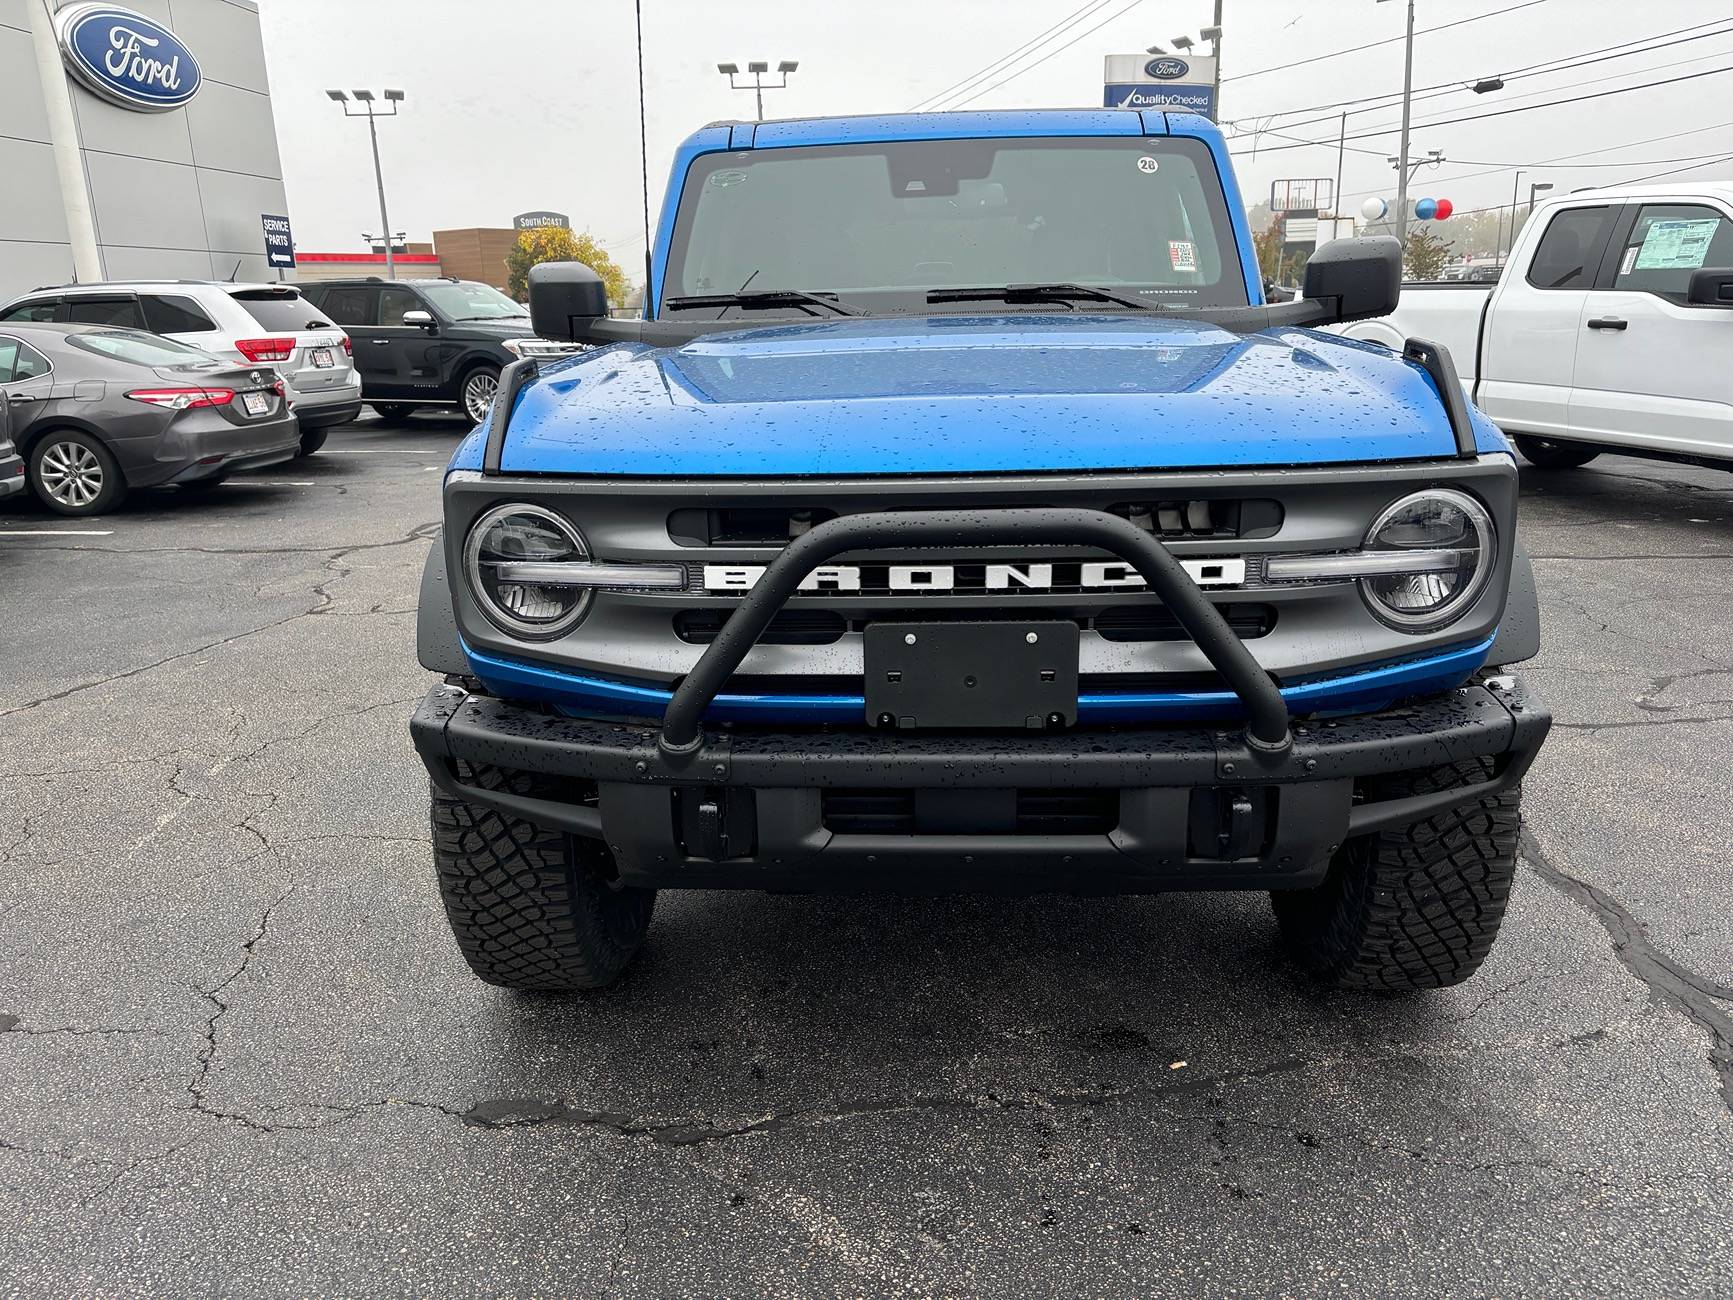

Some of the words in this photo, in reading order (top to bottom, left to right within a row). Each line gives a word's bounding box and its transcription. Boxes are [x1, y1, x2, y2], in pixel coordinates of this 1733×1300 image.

[105, 26, 181, 90] Ford
[1156, 61, 1181, 75] Ford
[1132, 94, 1209, 105] QualityChecked
[263, 219, 290, 232] SERVICE
[520, 217, 541, 227] SOUTH
[542, 216, 562, 226] COAST
[268, 233, 289, 247] PARTS
[703, 558, 1246, 591] BRONCO
